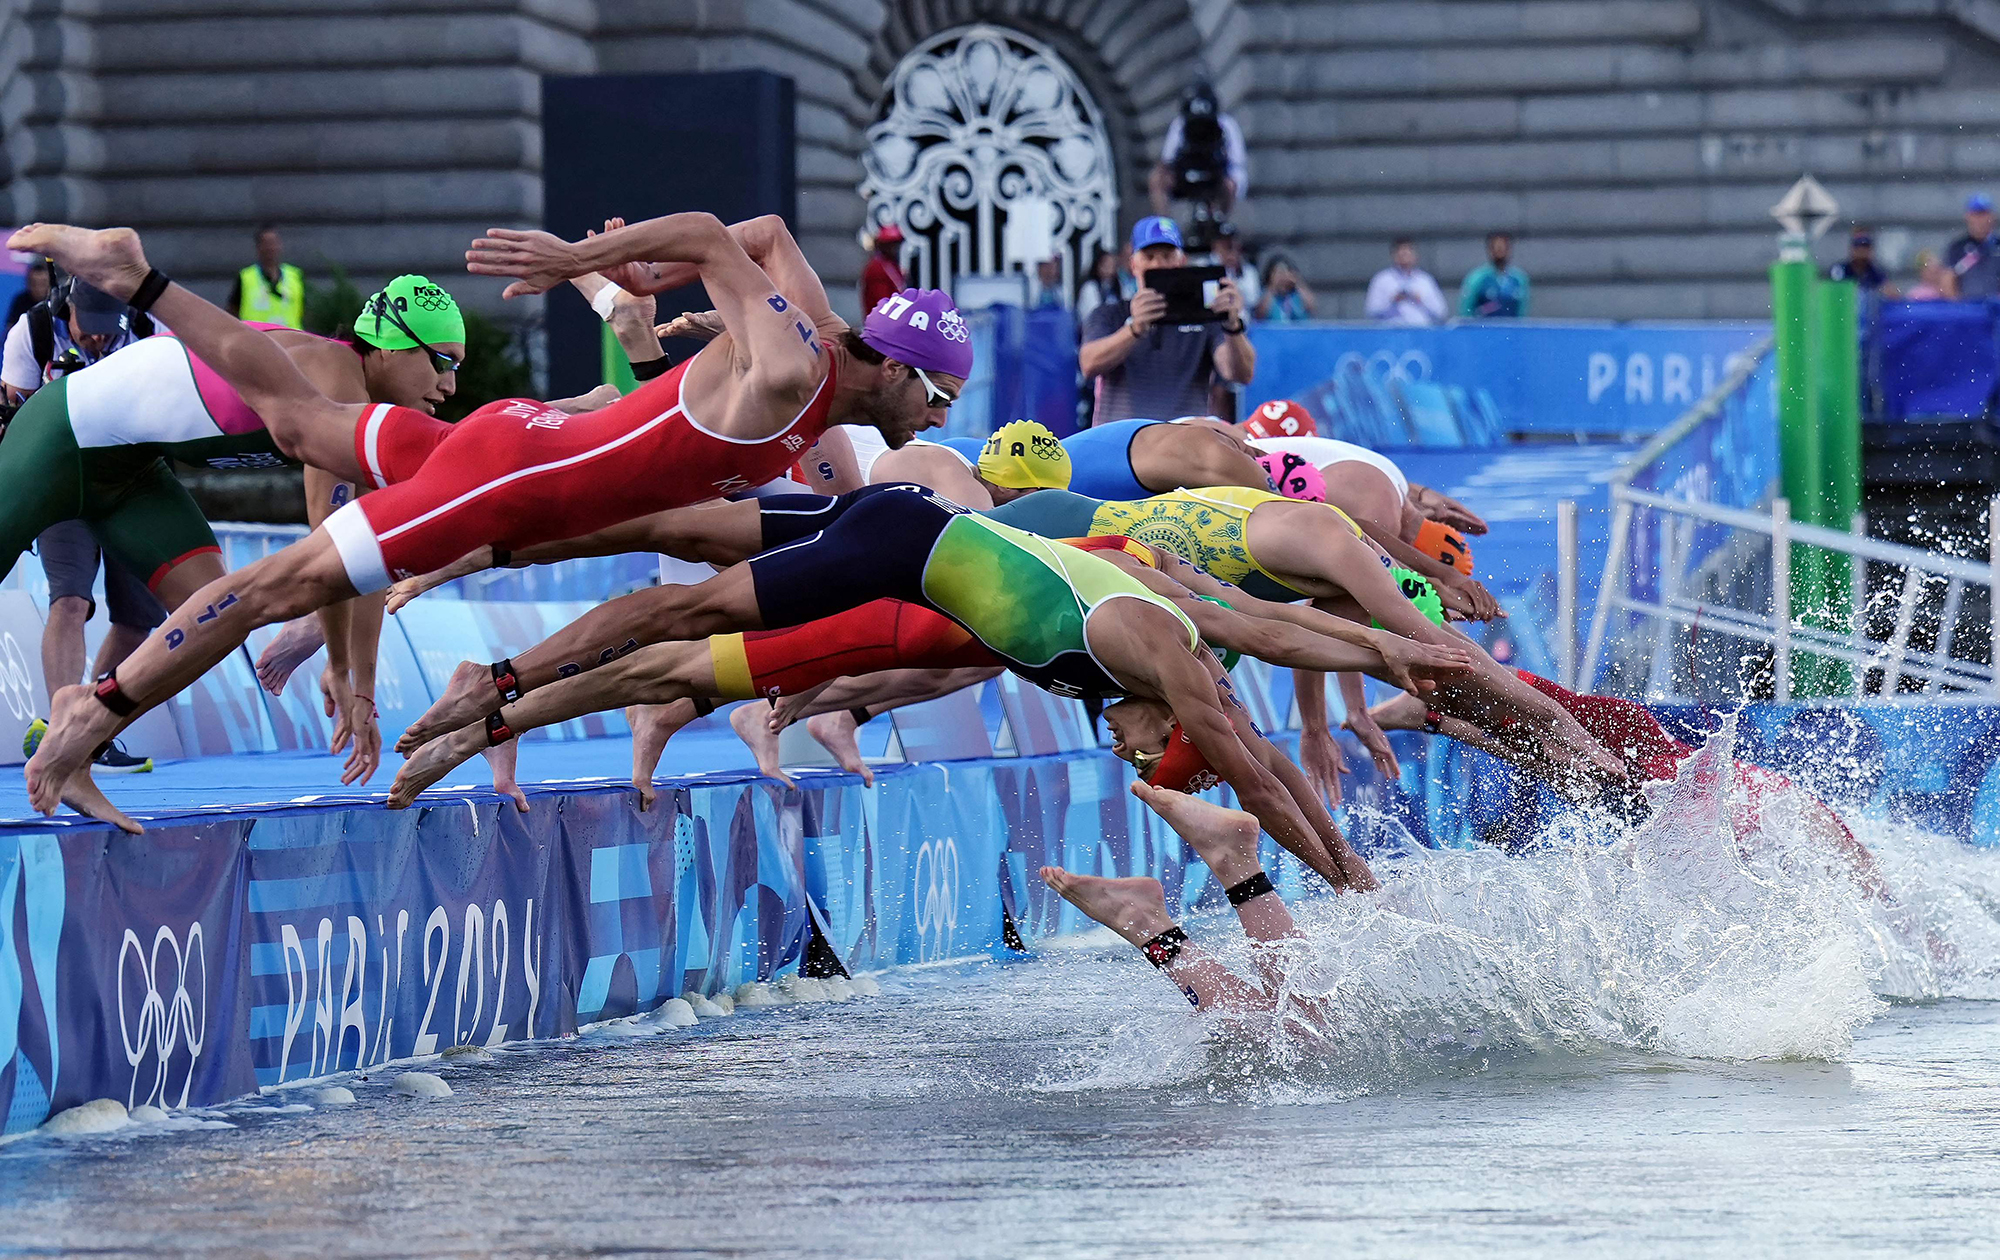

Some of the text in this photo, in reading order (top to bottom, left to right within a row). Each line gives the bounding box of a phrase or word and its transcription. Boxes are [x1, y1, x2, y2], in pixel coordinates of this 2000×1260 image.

[879, 296, 930, 331] 17 A
[1262, 400, 1300, 436] 3 A
[1010, 441, 1025, 457] A
[1289, 477, 1307, 494] A
[1402, 578, 1427, 599] 5
[164, 627, 185, 652] A
